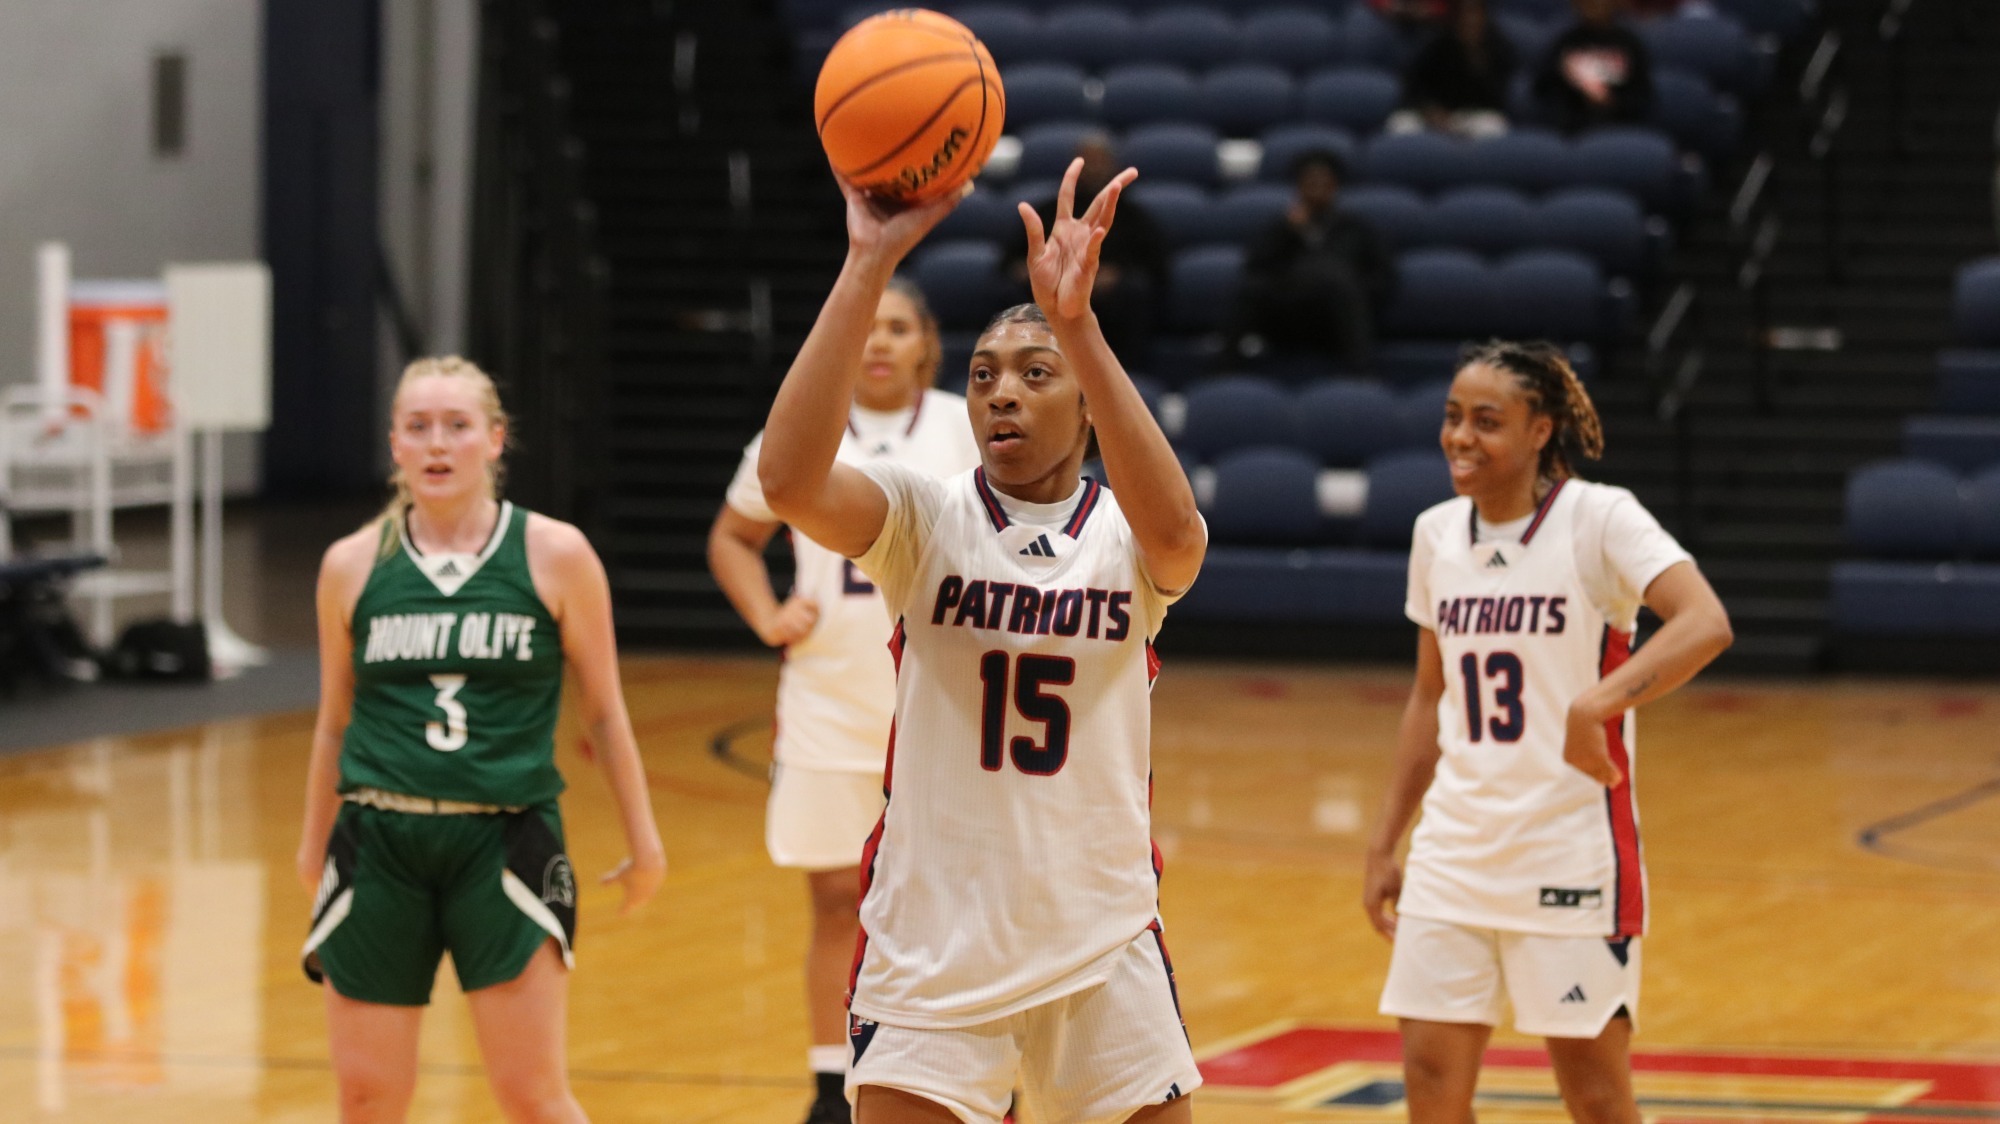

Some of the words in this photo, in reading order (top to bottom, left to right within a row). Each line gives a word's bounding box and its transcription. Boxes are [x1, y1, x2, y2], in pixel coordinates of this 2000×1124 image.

[887, 127, 970, 195] ilson
[364, 612, 457, 663] MOUNT
[458, 612, 537, 661] OLIVE
[931, 575, 1132, 641] PATRIOTS
[1438, 596, 1567, 635] PATRIOTS
[425, 674, 468, 752] 3
[980, 649, 1076, 776] 15
[1461, 651, 1525, 743] 13
